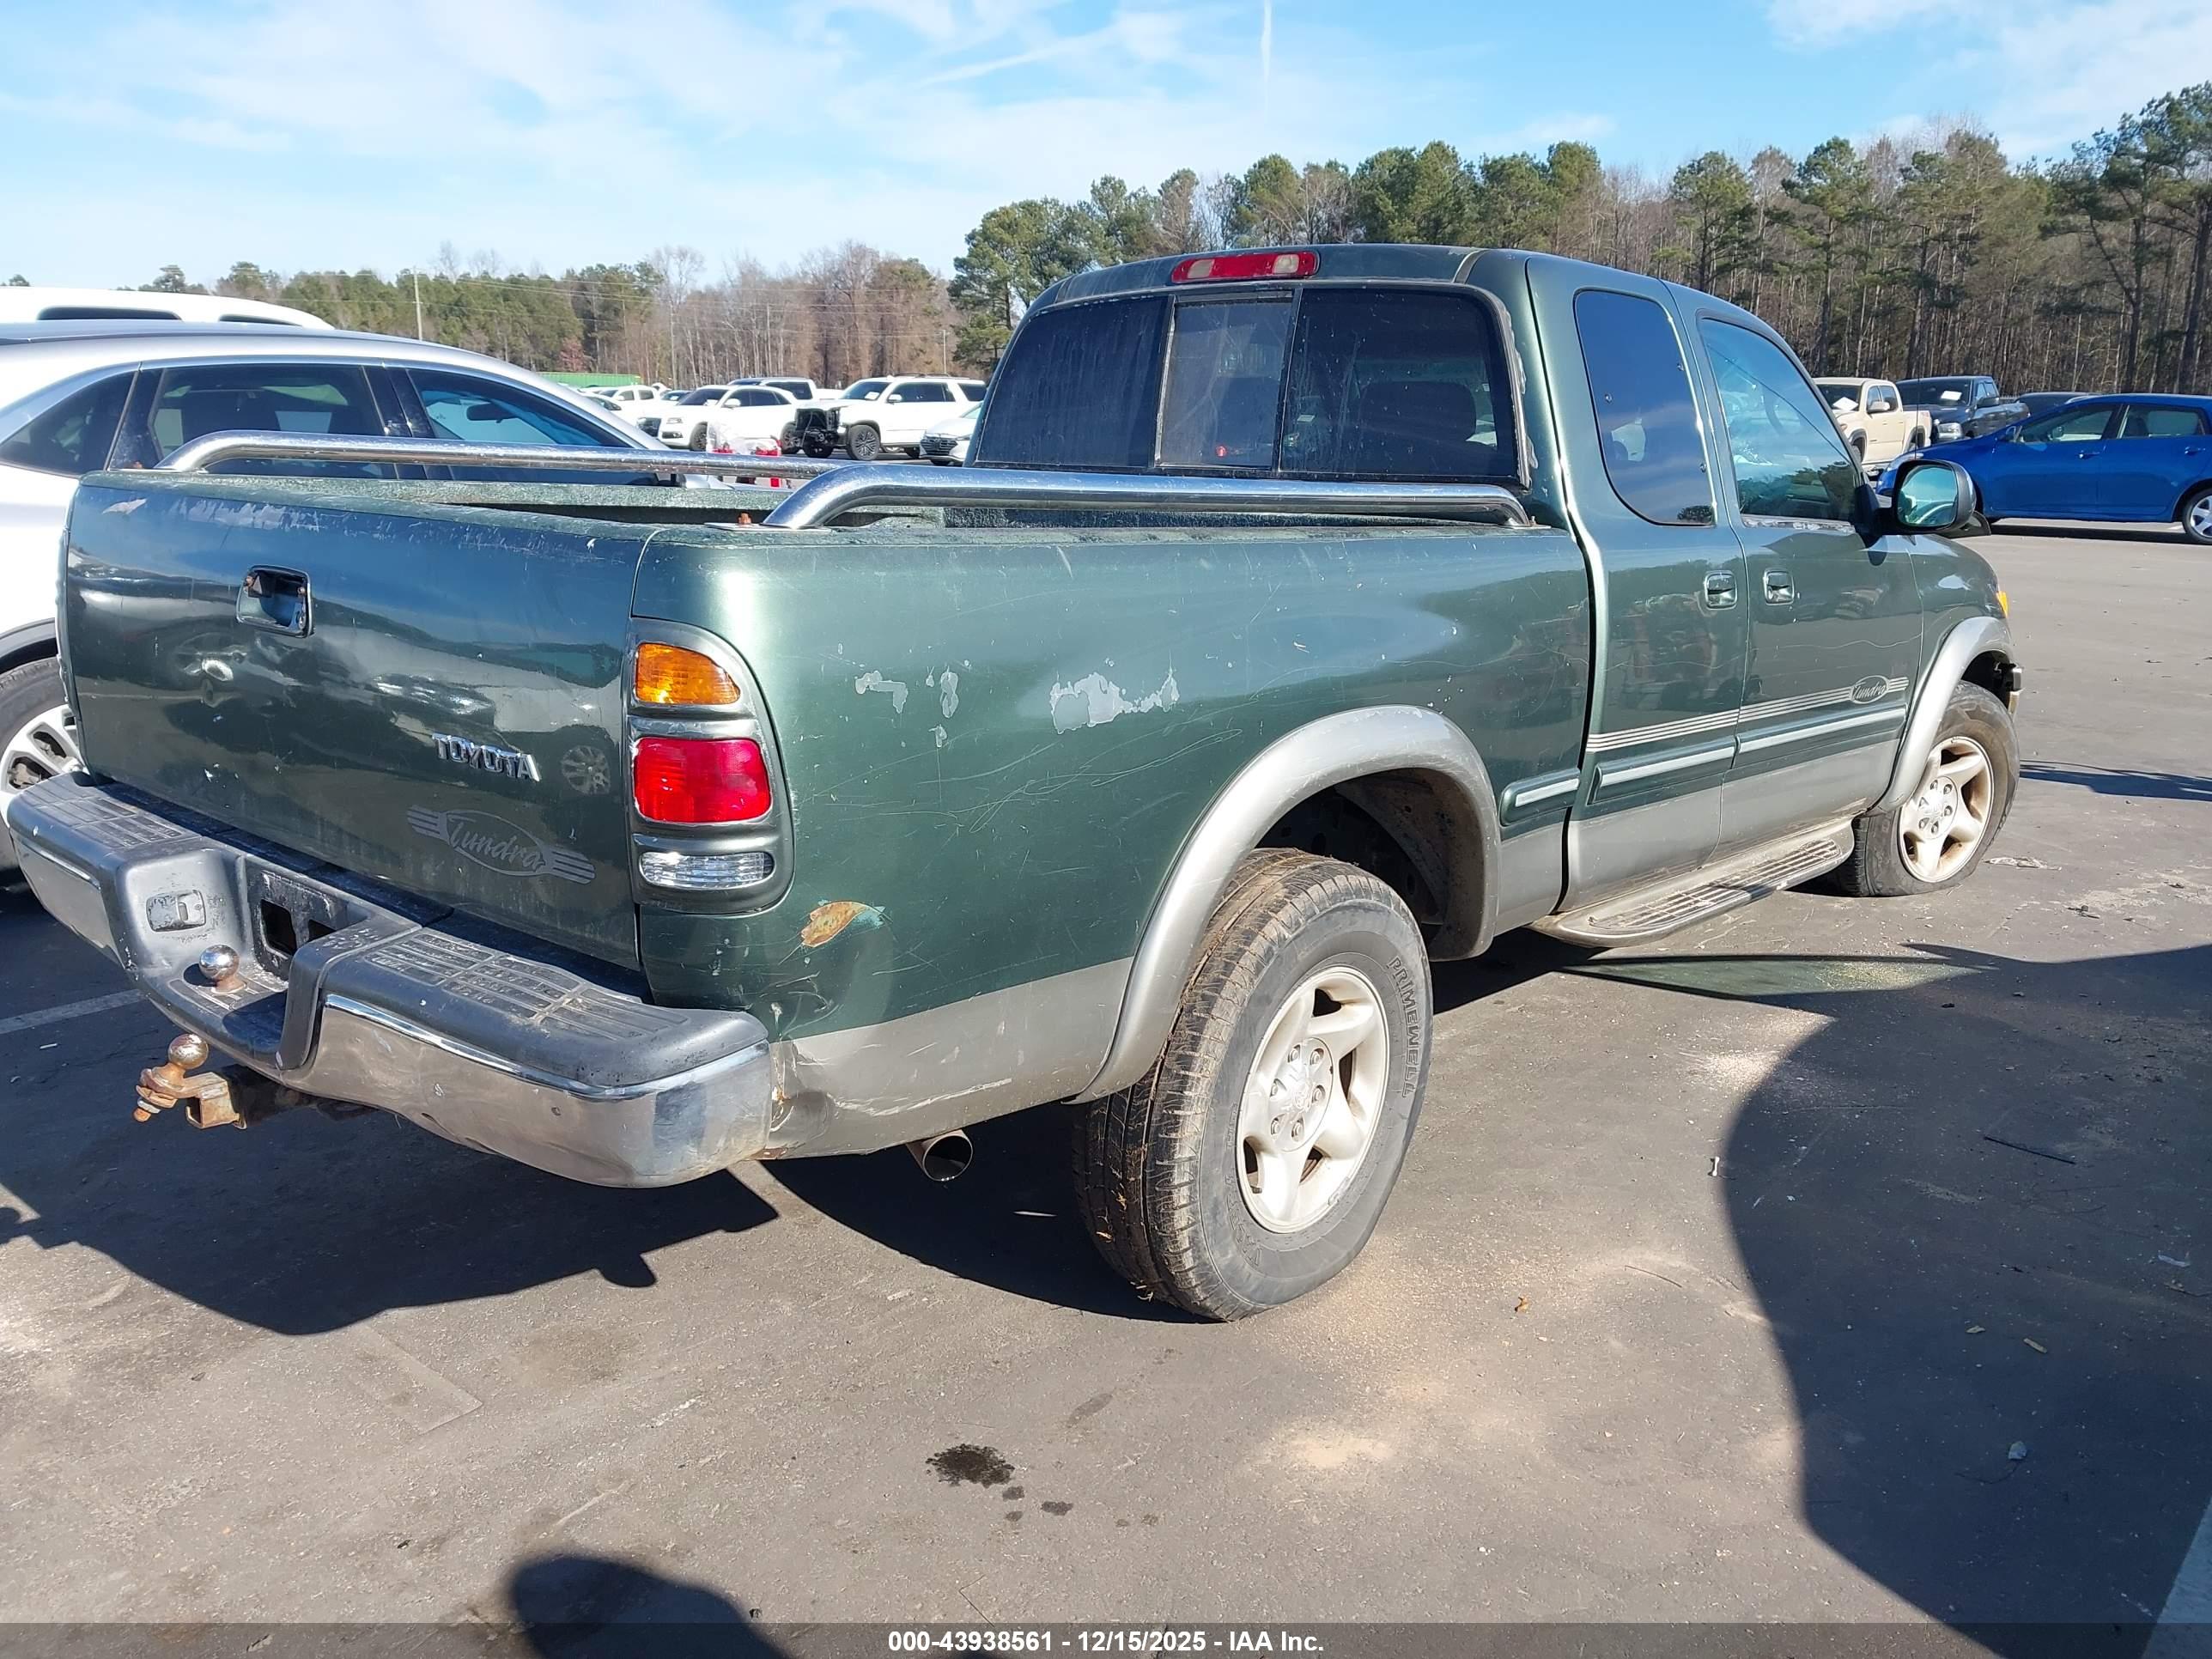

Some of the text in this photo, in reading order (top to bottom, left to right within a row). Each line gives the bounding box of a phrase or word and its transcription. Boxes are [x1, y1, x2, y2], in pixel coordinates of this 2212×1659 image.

[1852, 681, 1887, 699] Tundra
[432, 732, 540, 781] TOYOTA
[448, 818, 545, 868] Tundra
[1387, 956, 1420, 1097] PRIMEWELL
